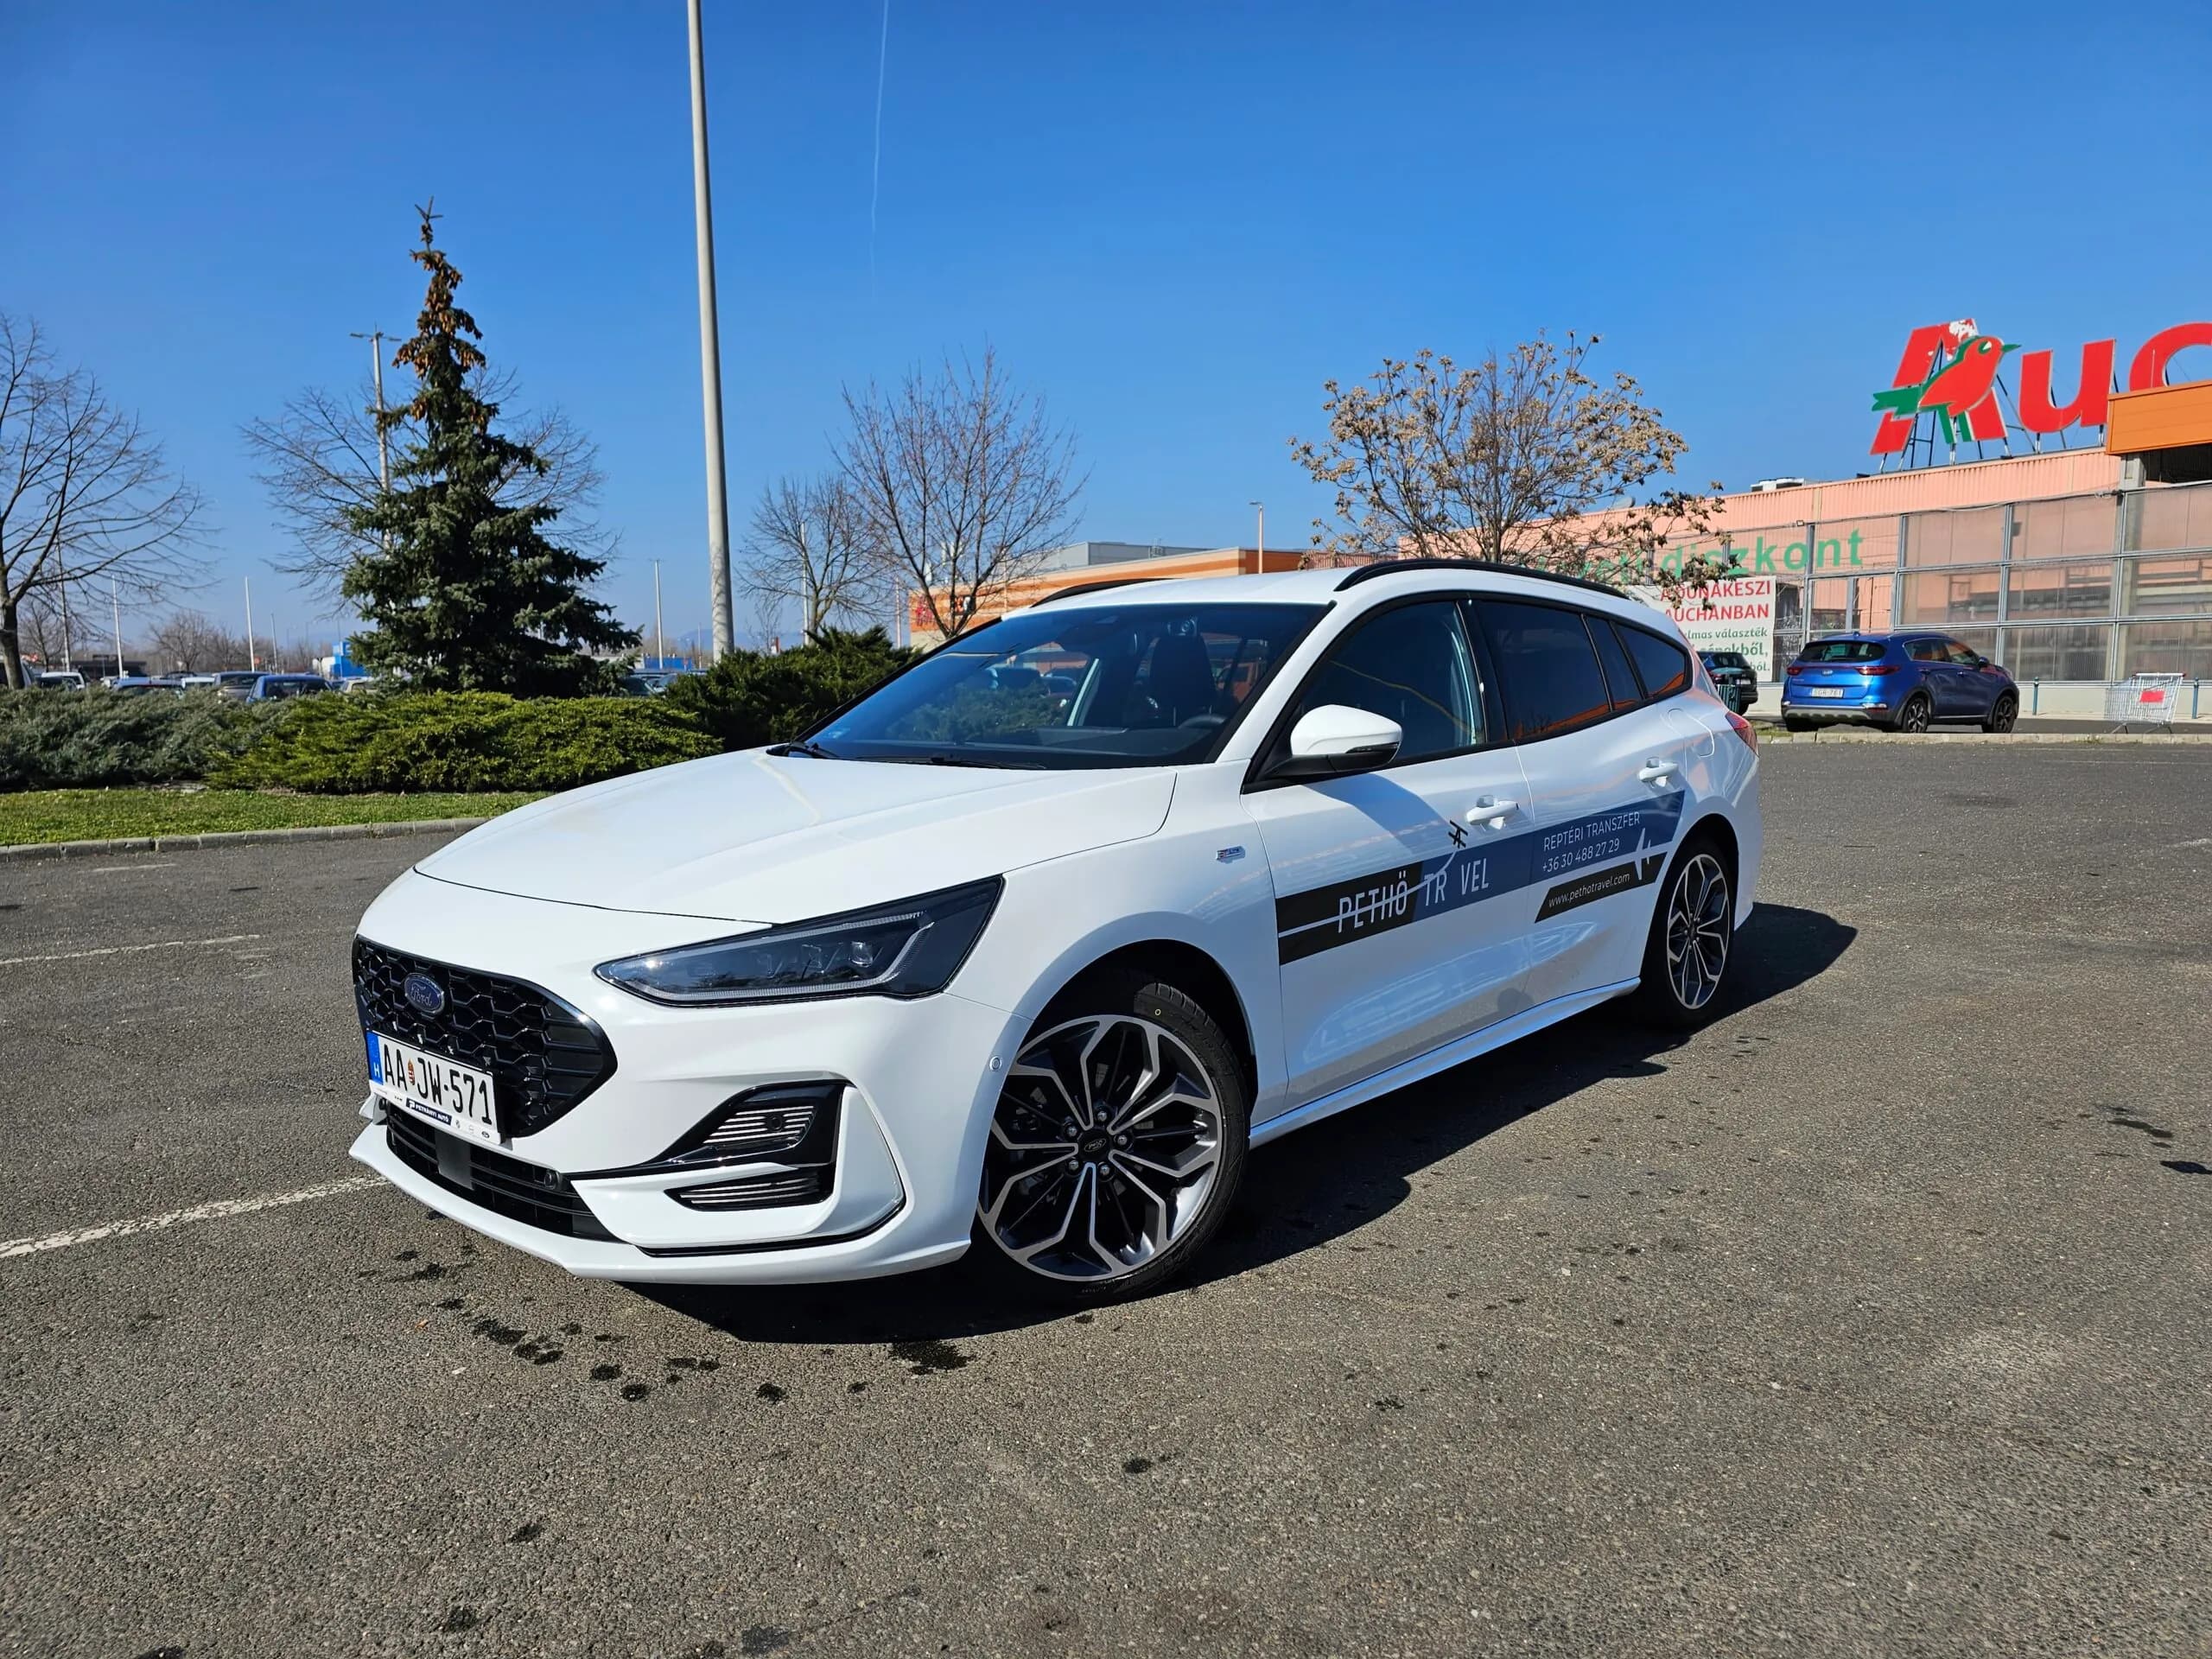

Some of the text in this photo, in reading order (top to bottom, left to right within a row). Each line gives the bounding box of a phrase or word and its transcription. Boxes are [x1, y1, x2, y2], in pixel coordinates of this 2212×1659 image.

[1715, 627, 1768, 638] választék
[1543, 811, 1640, 852] REPTÉRI TRANSZFER
[1542, 838, 1620, 873] +36 30 488 27 29
[1338, 870, 1408, 933] PETHÖ
[1548, 873, 1630, 907] www.pethotravel.com
[410, 982, 433, 1007] Ford
[373, 1063, 381, 1078] H
[384, 1044, 493, 1125] AA JW-571
